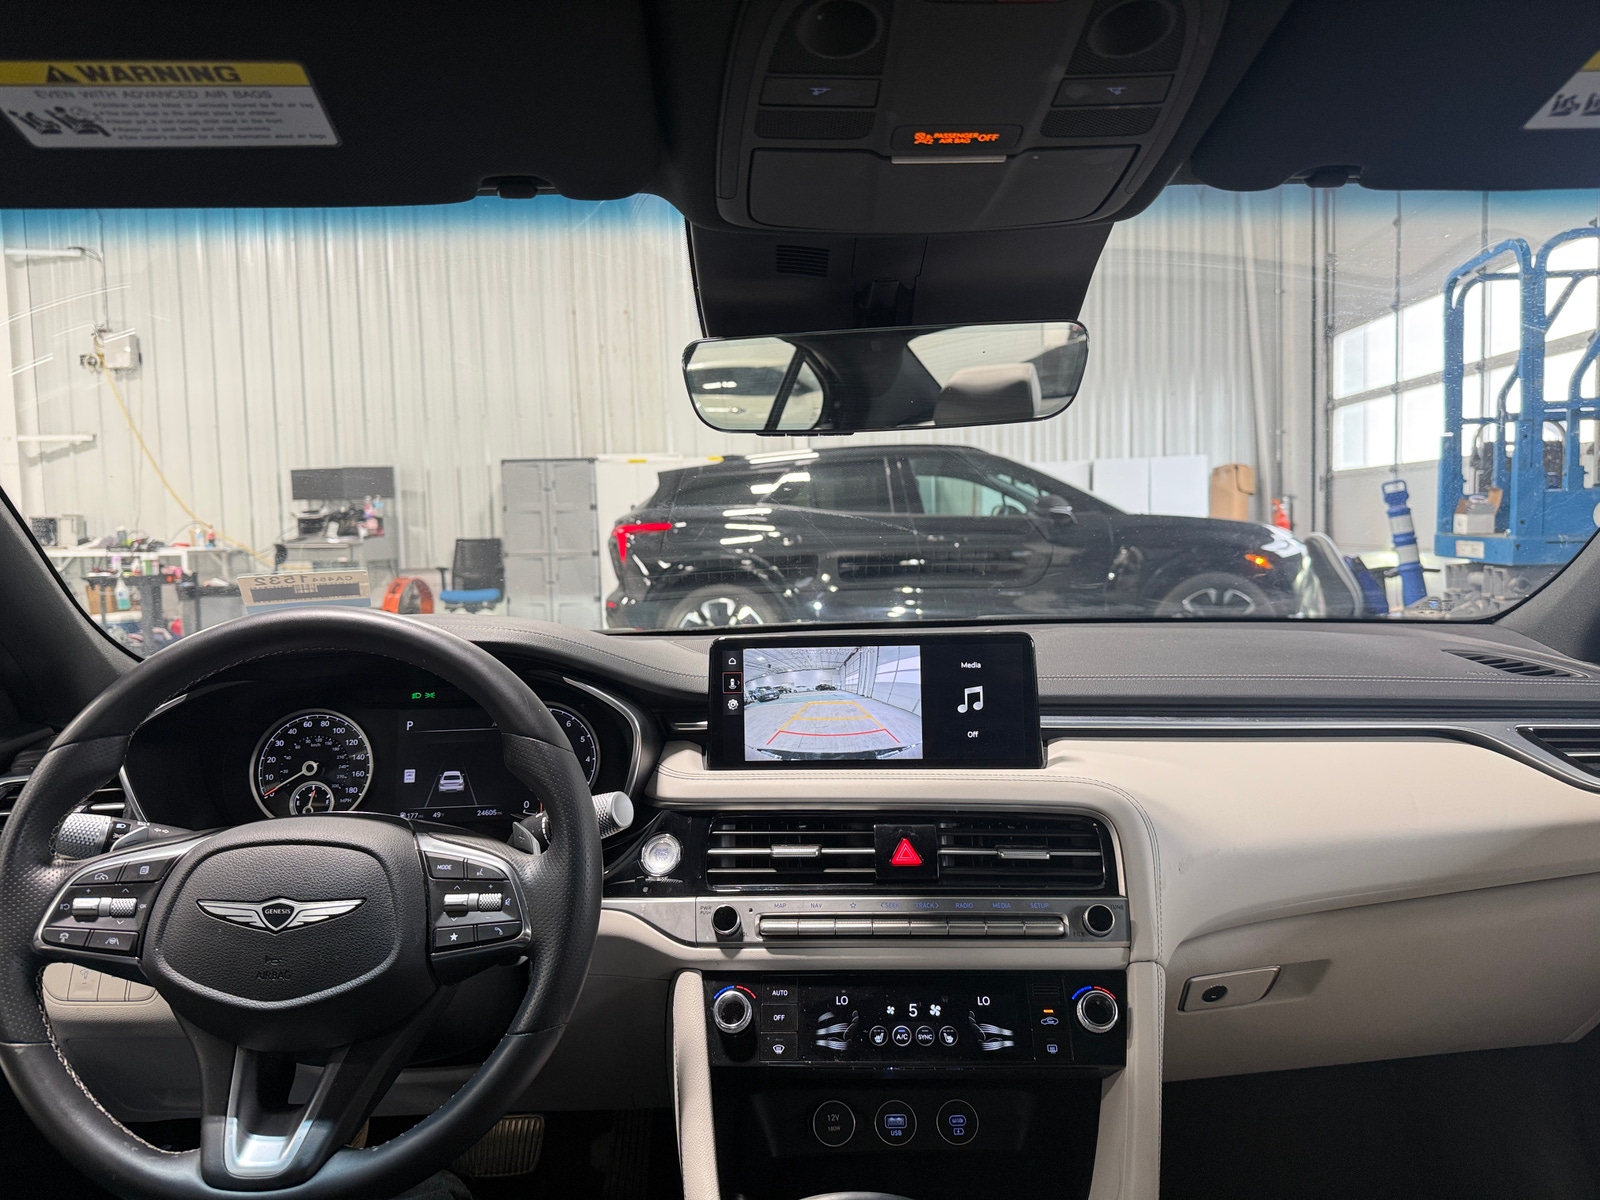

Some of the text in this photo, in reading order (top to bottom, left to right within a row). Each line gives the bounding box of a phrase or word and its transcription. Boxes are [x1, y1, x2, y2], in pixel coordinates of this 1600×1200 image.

[75, 65, 242, 83] WARNING
[34, 90, 273, 99] EVEN WITH ADVANCED AIR BAGS
[977, 133, 1000, 142] OFF
[960, 661, 982, 669] Media
[406, 720, 414, 731] P
[580, 735, 586, 743] 5
[523, 800, 530, 809] 0
[255, 970, 292, 980] AIRBAG
[835, 996, 849, 1005] LO
[977, 996, 991, 1006] LO
[909, 1003, 918, 1018] 5
[896, 1032, 909, 1041] A/C
[827, 1113, 840, 1122] 12V
